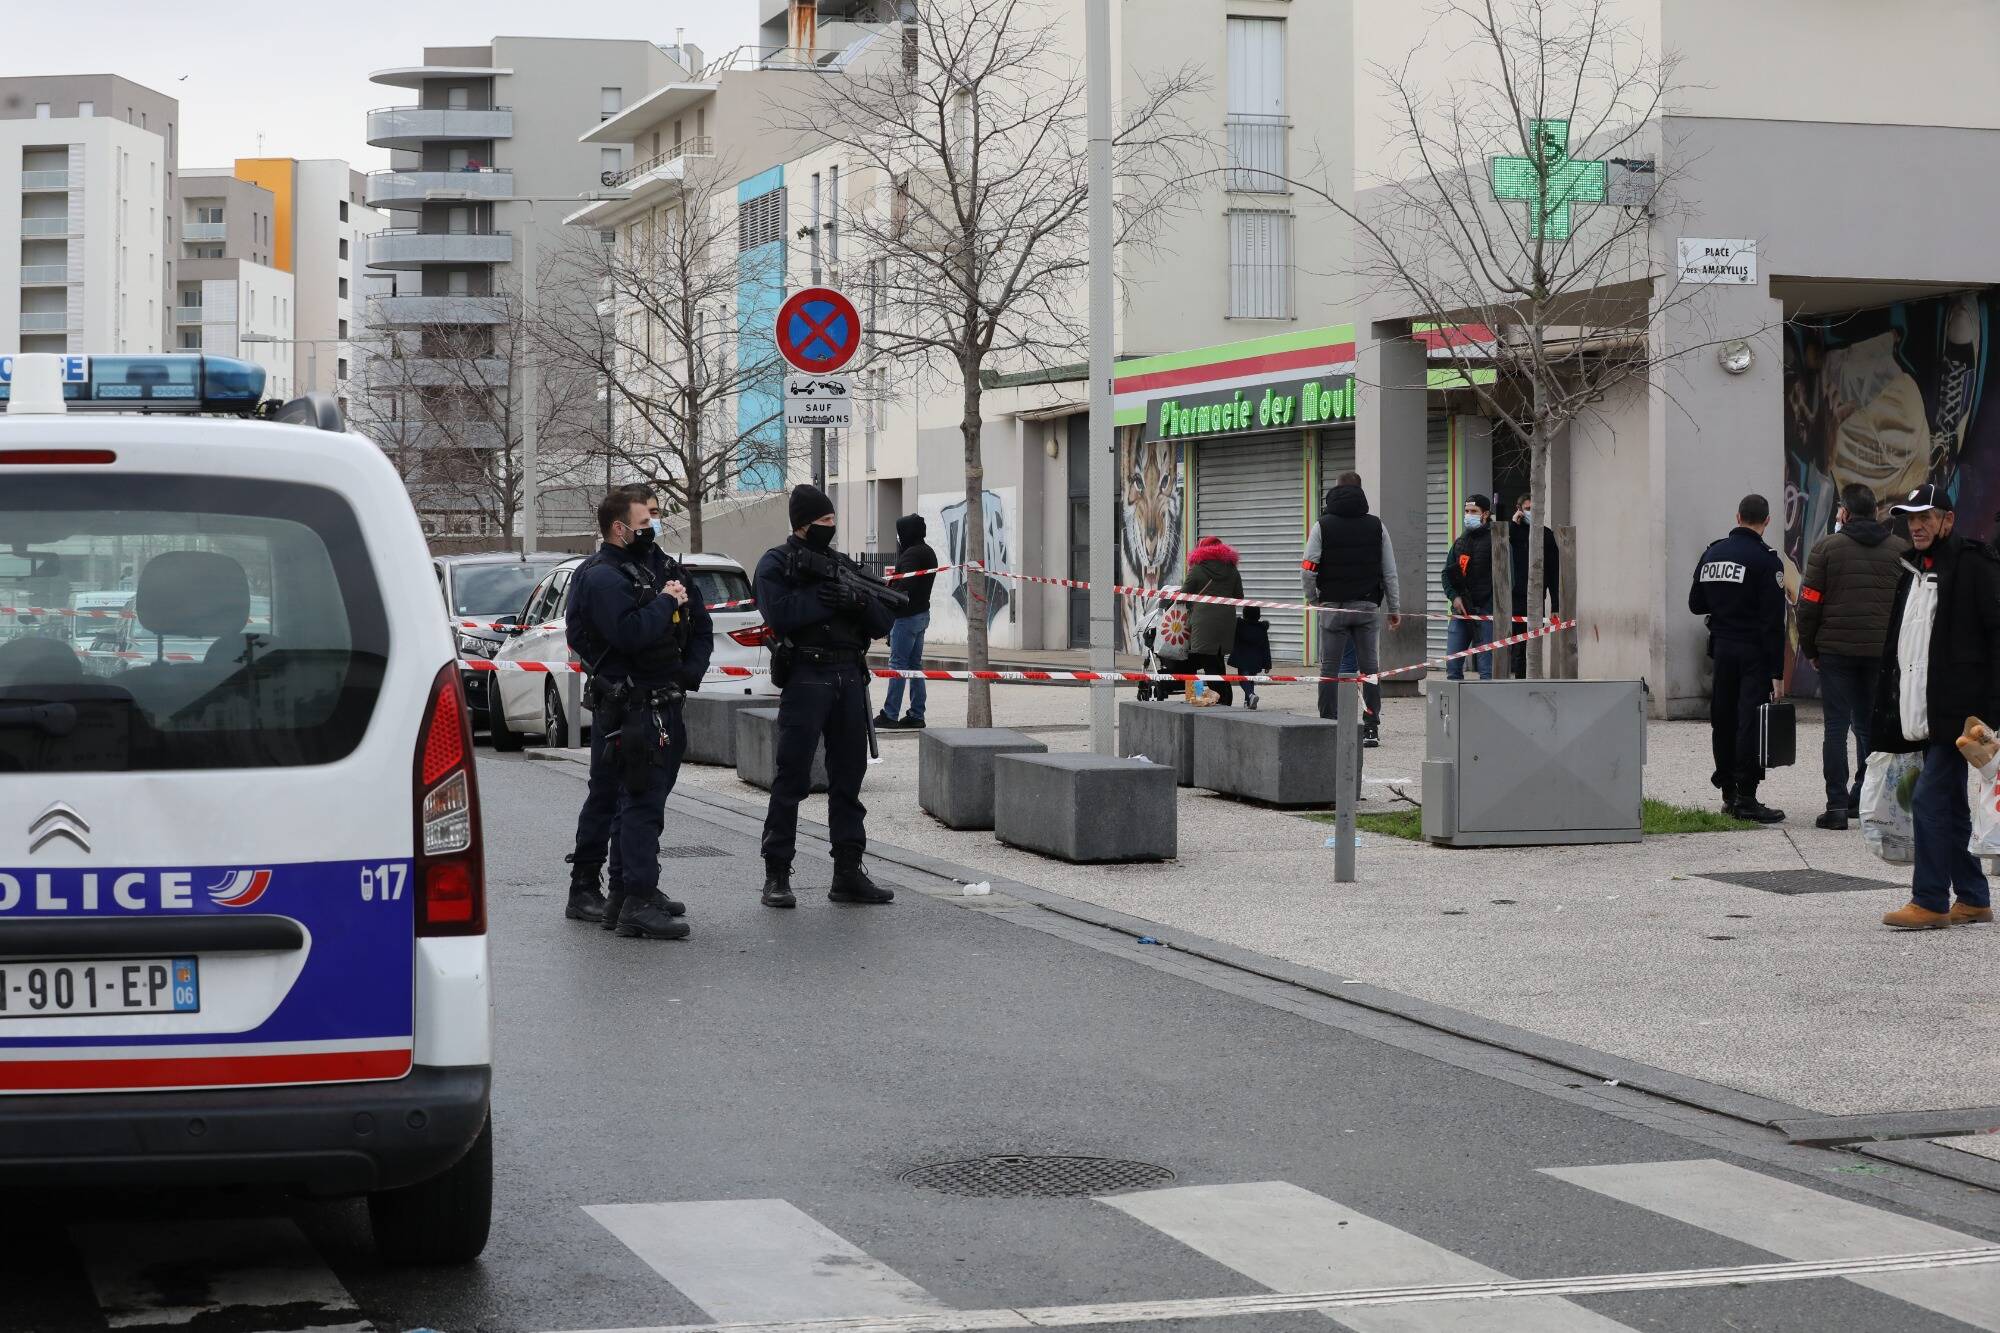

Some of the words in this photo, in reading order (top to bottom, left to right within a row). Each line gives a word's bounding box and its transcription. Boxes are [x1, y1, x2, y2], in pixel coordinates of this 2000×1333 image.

[1705, 247, 1729, 257] PLACE
[1702, 265, 1748, 275] AMARYLLIS
[805, 403, 832, 412] SAUF
[1160, 391, 1253, 437] Pharmacie
[1259, 388, 1295, 426] des
[1301, 377, 1355, 421] Moul
[788, 414, 849, 424] LIVONS
[1701, 563, 1743, 580] POLICE
[375, 863, 408, 901] 17
[0, 965, 168, 1011] -901-EP
[176, 986, 194, 1005] 06
